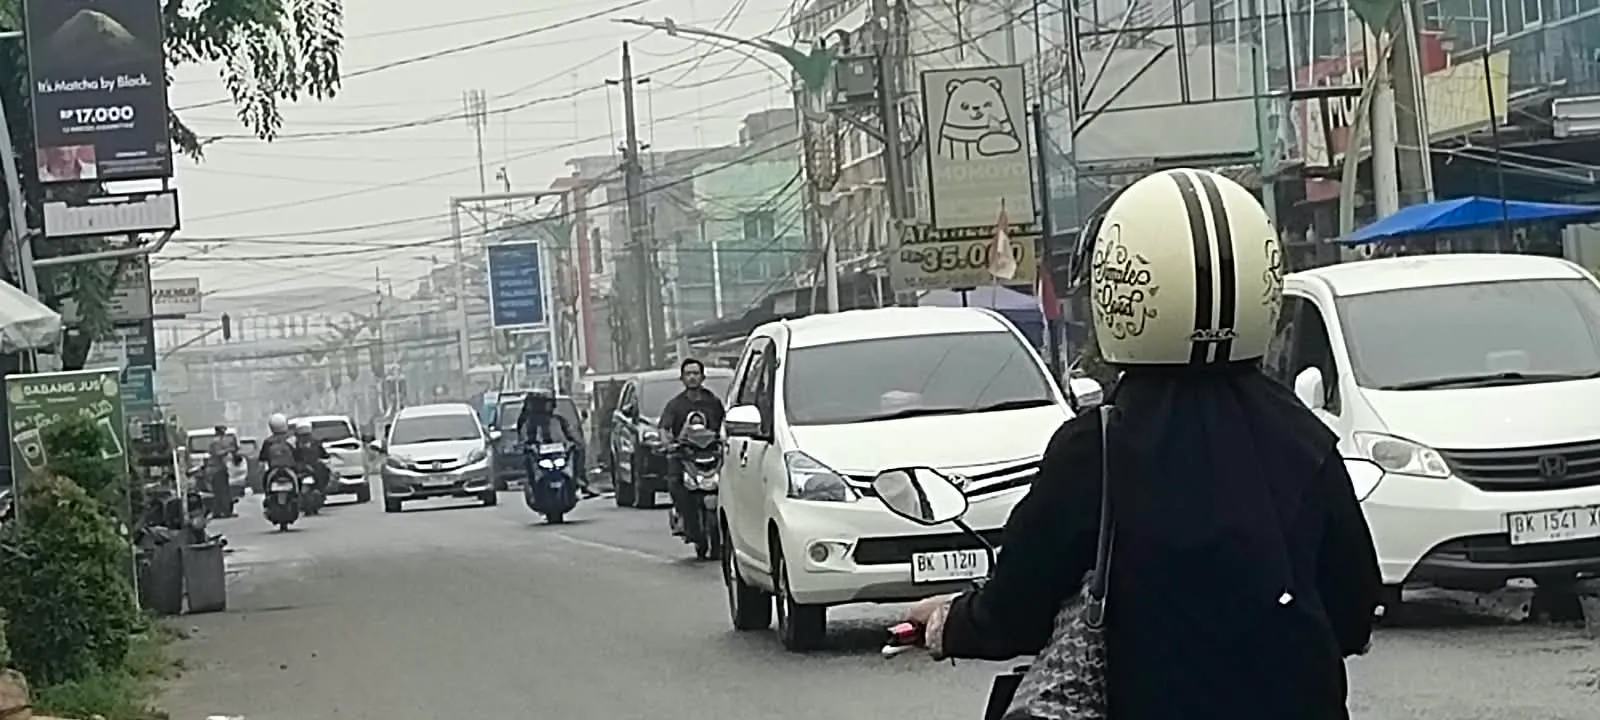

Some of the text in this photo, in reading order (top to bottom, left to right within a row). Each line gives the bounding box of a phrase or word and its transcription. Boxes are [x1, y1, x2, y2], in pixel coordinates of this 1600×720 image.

[54, 77, 98, 91] Matcha
[100, 76, 115, 92] by
[75, 105, 134, 124] 17.000
[938, 160, 1026, 183] MOMOYO
[920, 242, 1024, 272] 35.00
[1515, 510, 1600, 532] BK 1541 X
[917, 552, 977, 572] BK 1120
